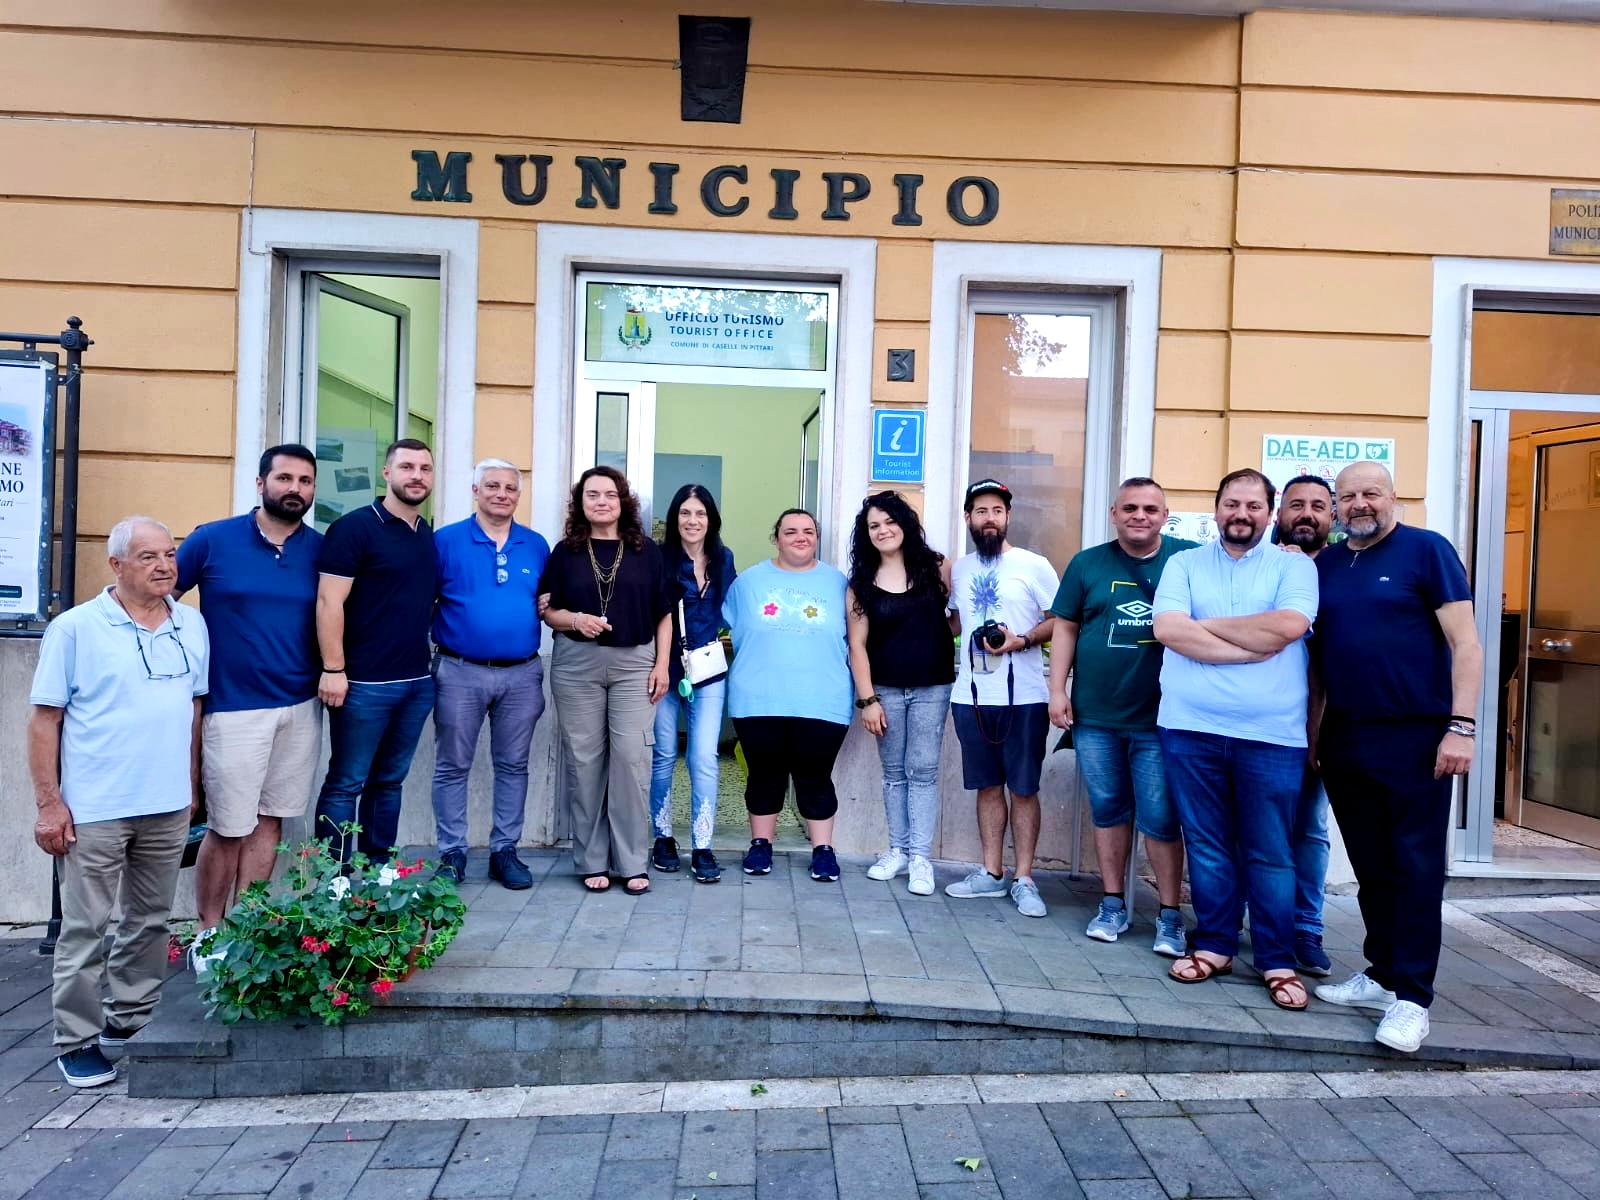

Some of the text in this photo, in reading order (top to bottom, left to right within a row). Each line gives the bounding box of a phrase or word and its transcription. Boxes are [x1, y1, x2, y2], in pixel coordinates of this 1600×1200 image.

[411, 150, 1000, 226] MUNICIPIO
[1568, 204, 1600, 218] POLI
[665, 311, 784, 326] UFFICIO TURISMO
[670, 325, 774, 339] TOURIST OFFICE
[891, 351, 909, 381] 3
[1267, 439, 1360, 460] DAE-AED
[1, 462, 22, 476] NE
[884, 459, 912, 468] Tourist
[875, 468, 920, 477] information
[1117, 617, 1153, 627] umbro
